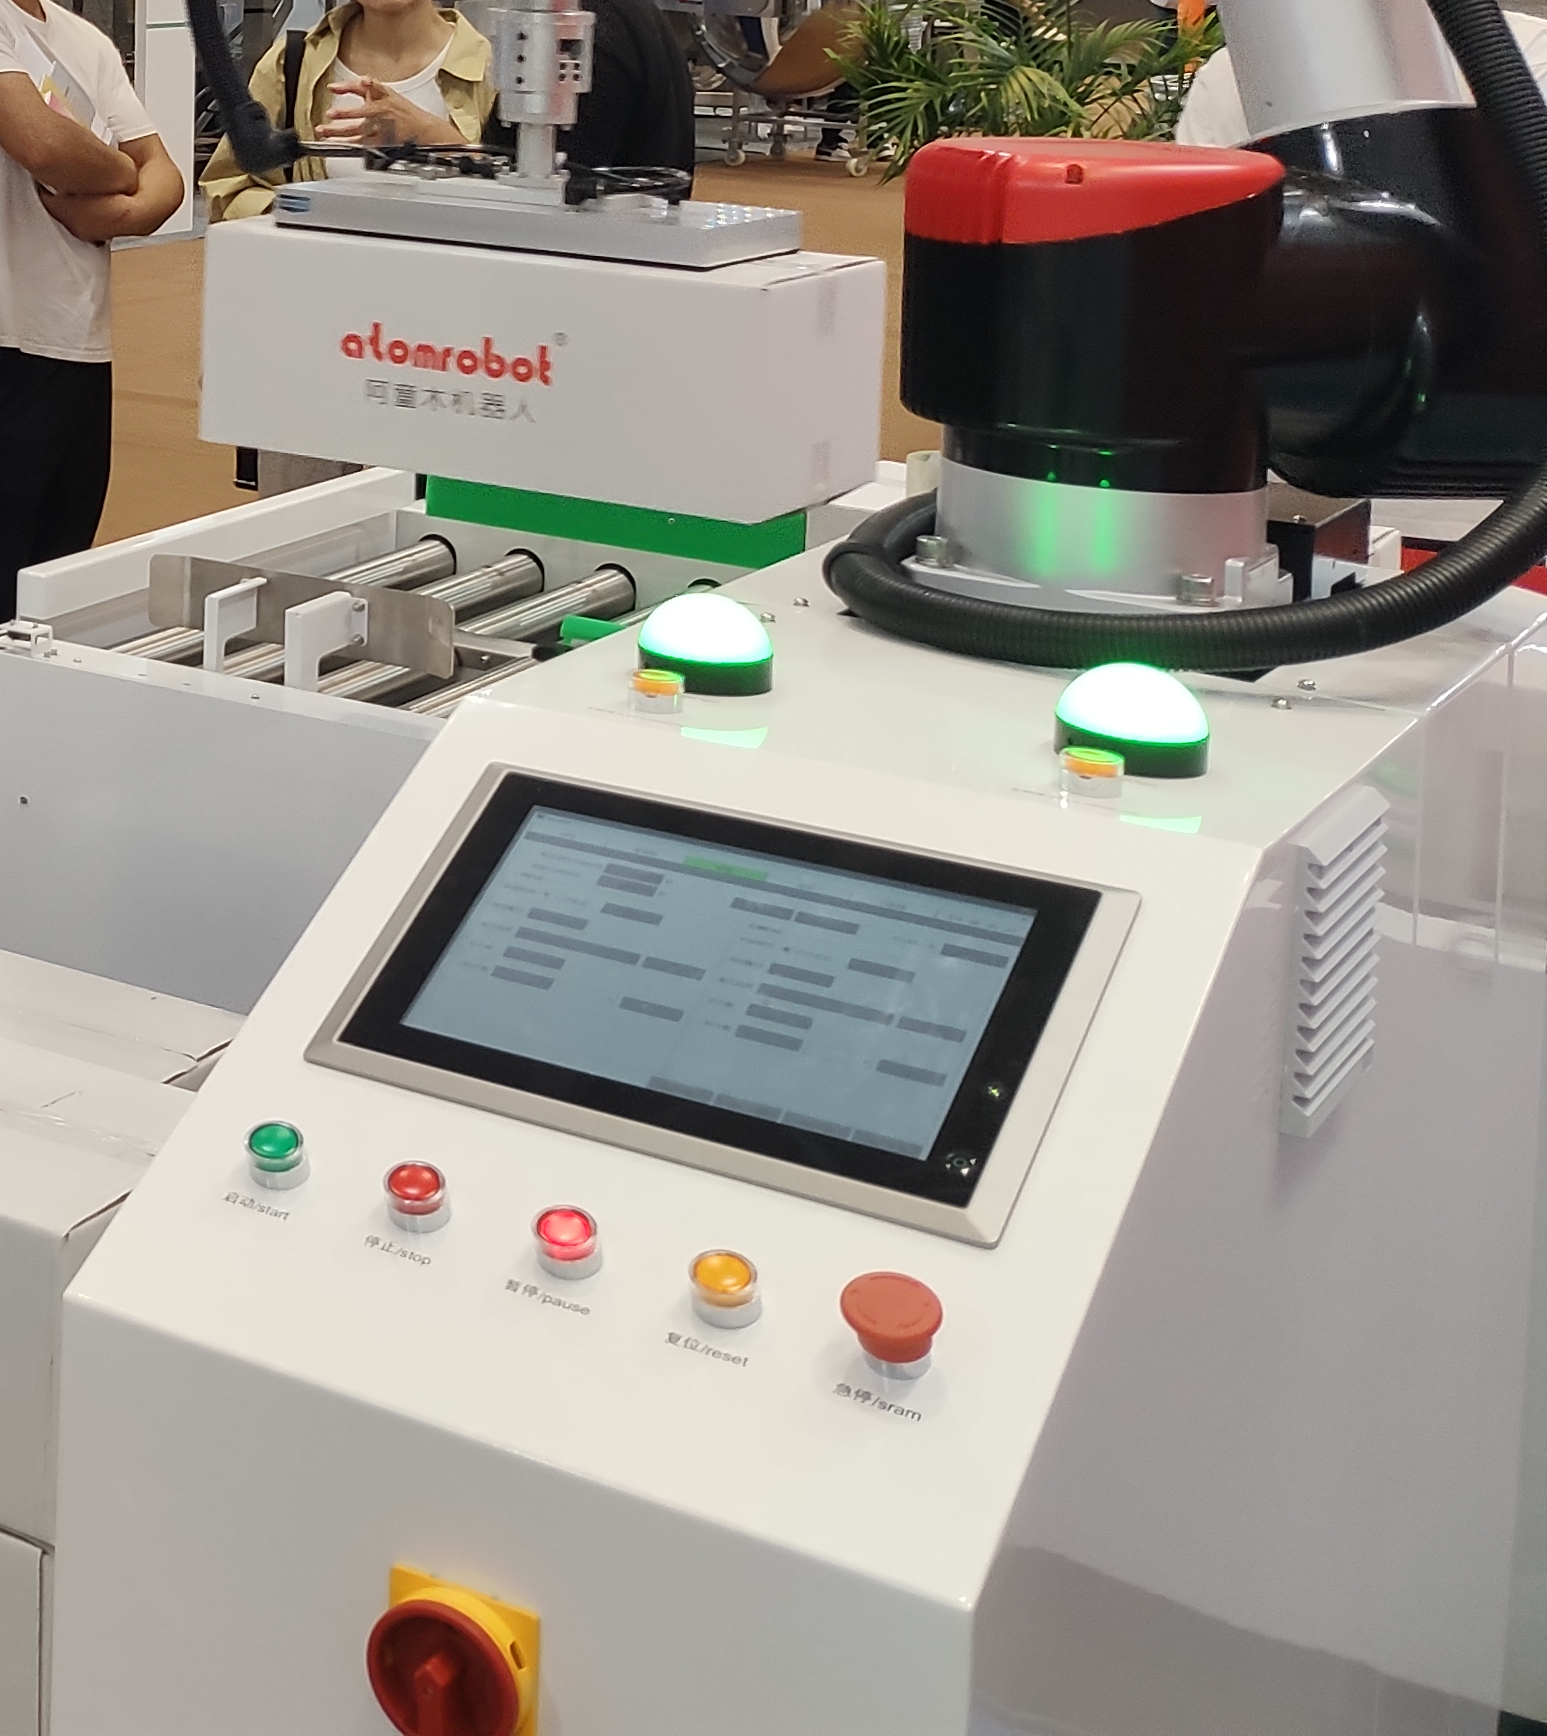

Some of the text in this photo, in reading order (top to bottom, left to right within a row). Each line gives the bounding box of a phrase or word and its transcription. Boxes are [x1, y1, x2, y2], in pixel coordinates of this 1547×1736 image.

[339, 320, 554, 388] atomrobot
[363, 376, 537, 425] 阿童木机器人
[223, 1191, 291, 1221] 启动/start
[363, 1233, 433, 1267] 停止/stop
[505, 1278, 592, 1317] 暂停/pause
[664, 1330, 749, 1368] 复位/reset
[832, 1381, 923, 1423] 急停/sram
